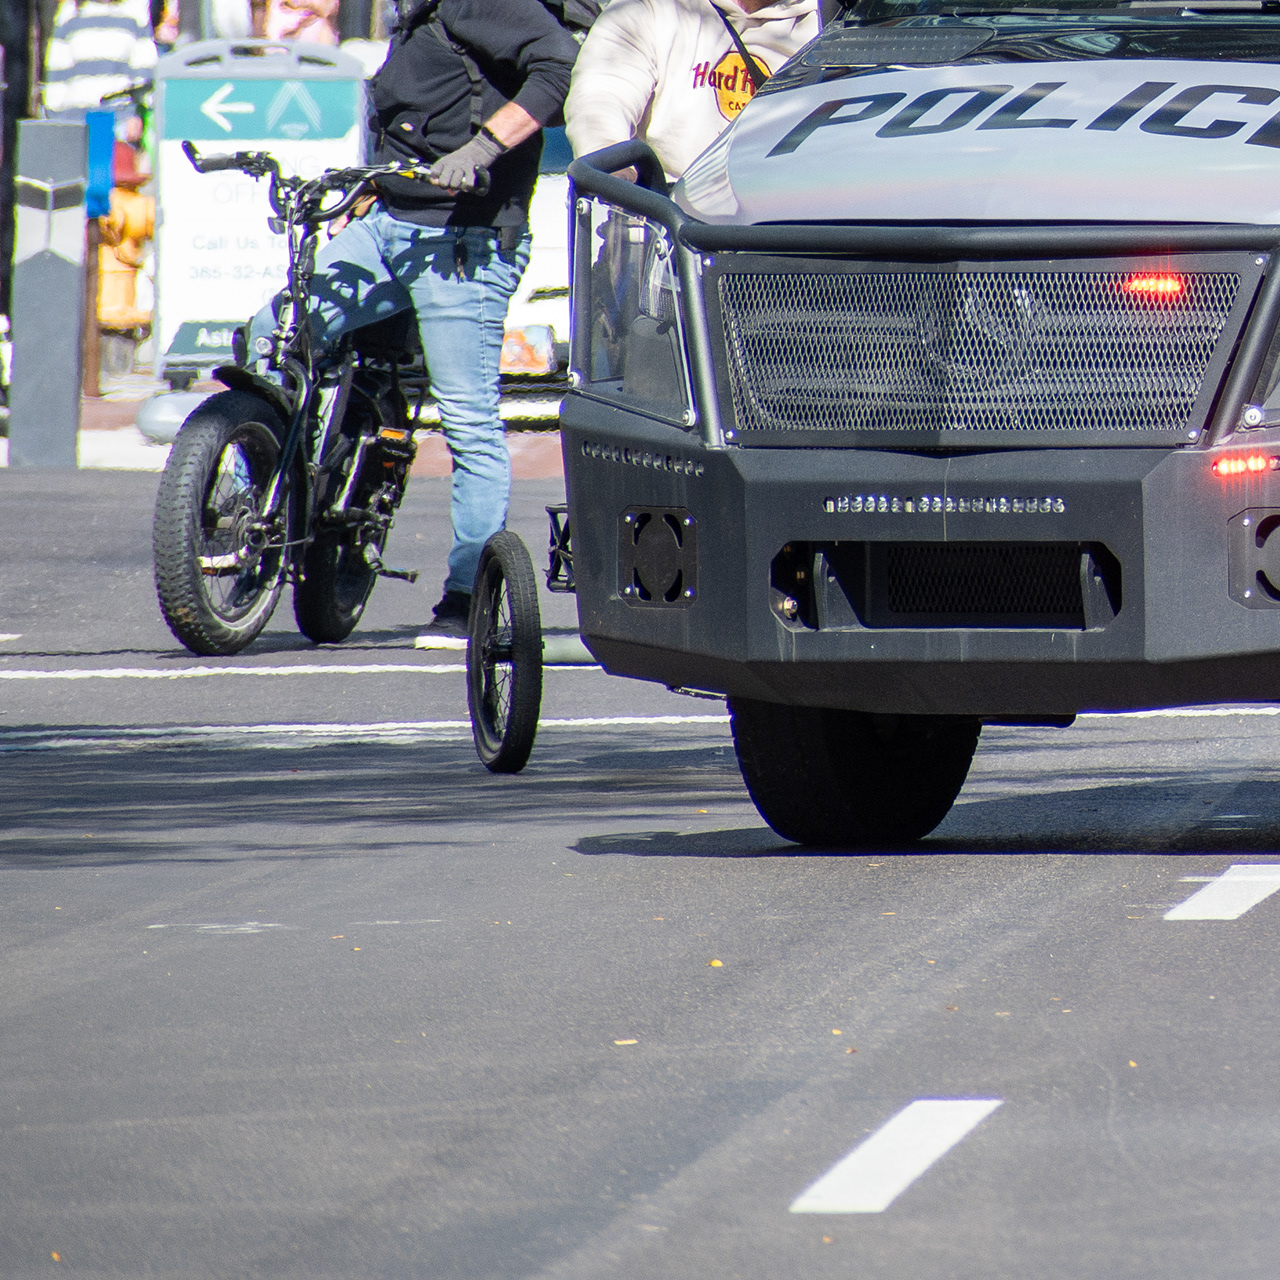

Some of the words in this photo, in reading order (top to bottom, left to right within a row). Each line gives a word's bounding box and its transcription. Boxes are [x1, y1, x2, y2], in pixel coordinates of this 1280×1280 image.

[692, 61, 739, 93] Hard
[728, 101, 746, 111] CA
[192, 234, 228, 251] Call
[236, 235, 259, 251] Us
[189, 264, 287, 280] 385-32-AS
